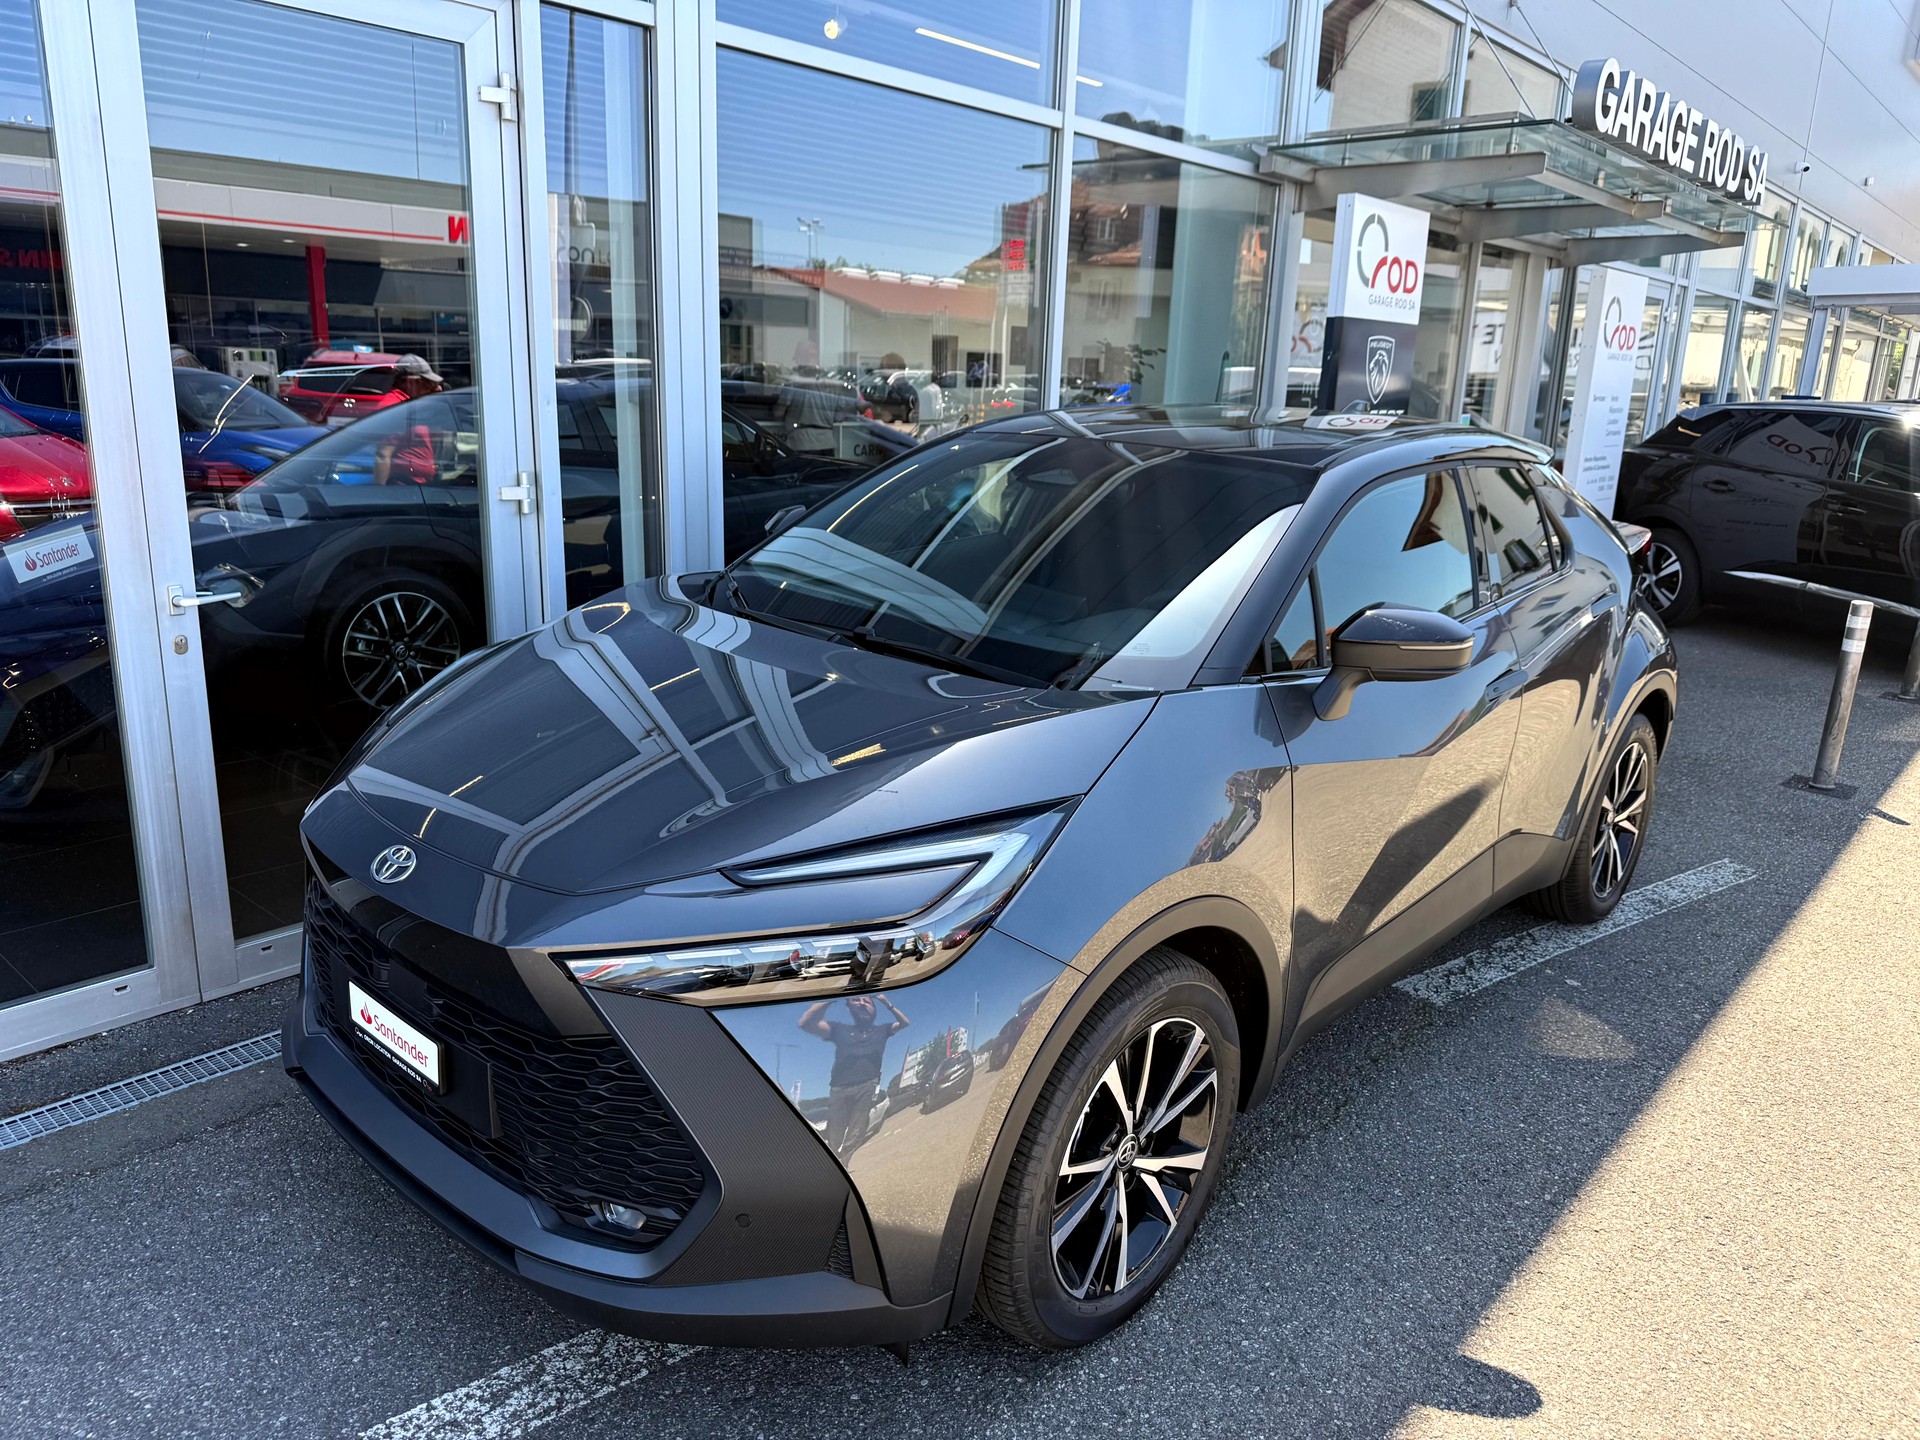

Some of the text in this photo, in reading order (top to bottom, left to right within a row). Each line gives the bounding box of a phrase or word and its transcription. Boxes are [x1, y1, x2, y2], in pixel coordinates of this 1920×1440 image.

[1595, 57, 1768, 205] GARAGE ROD SA
[1368, 294, 1416, 310] GARAGE ROD SA
[35, 542, 80, 568] Santander
[373, 1014, 428, 1068] Santander
